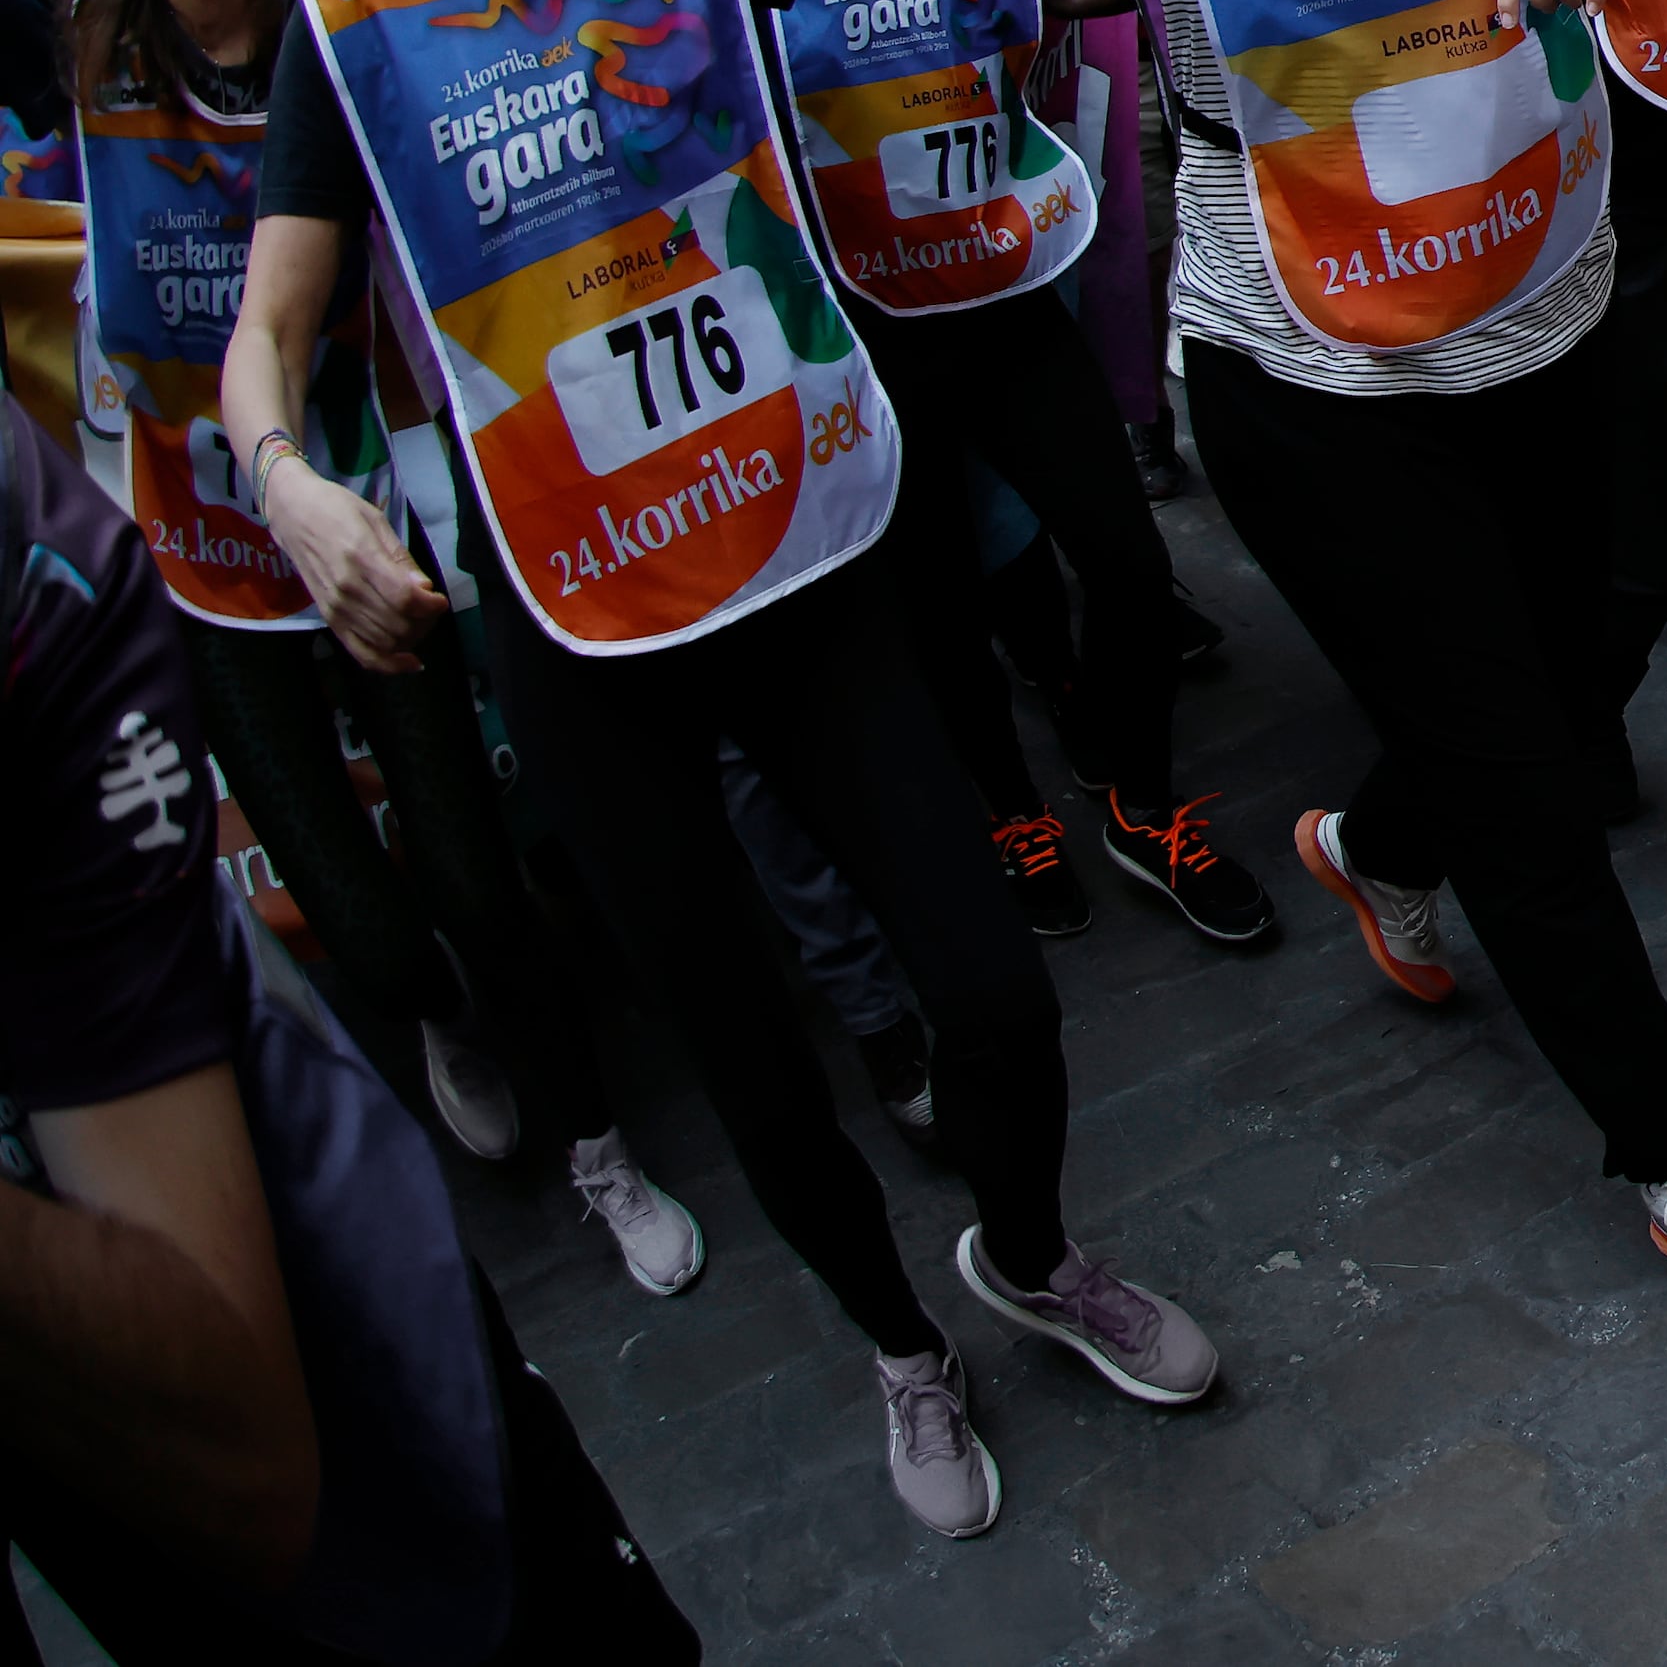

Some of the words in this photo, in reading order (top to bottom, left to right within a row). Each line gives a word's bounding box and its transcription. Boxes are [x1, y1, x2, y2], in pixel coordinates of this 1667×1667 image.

[441, 48, 539, 103] 24.korrika
[541, 36, 575, 68] aek
[1382, 18, 1485, 57] LABORAL
[1446, 39, 1488, 59] kutxa
[429, 69, 590, 164] Euskara
[902, 86, 969, 109] LABORAL
[465, 107, 605, 226] gara
[922, 121, 998, 200] 776
[1561, 110, 1601, 195] aek
[1032, 178, 1081, 234] aek
[1316, 188, 1544, 296] 24.korrika
[567, 246, 658, 300] LABORAL
[628, 270, 666, 293] kutxa
[854, 221, 1021, 281] 24.korrika
[605, 294, 745, 430] 776
[810, 375, 872, 466] aek
[550, 446, 784, 597] 24.korrika
